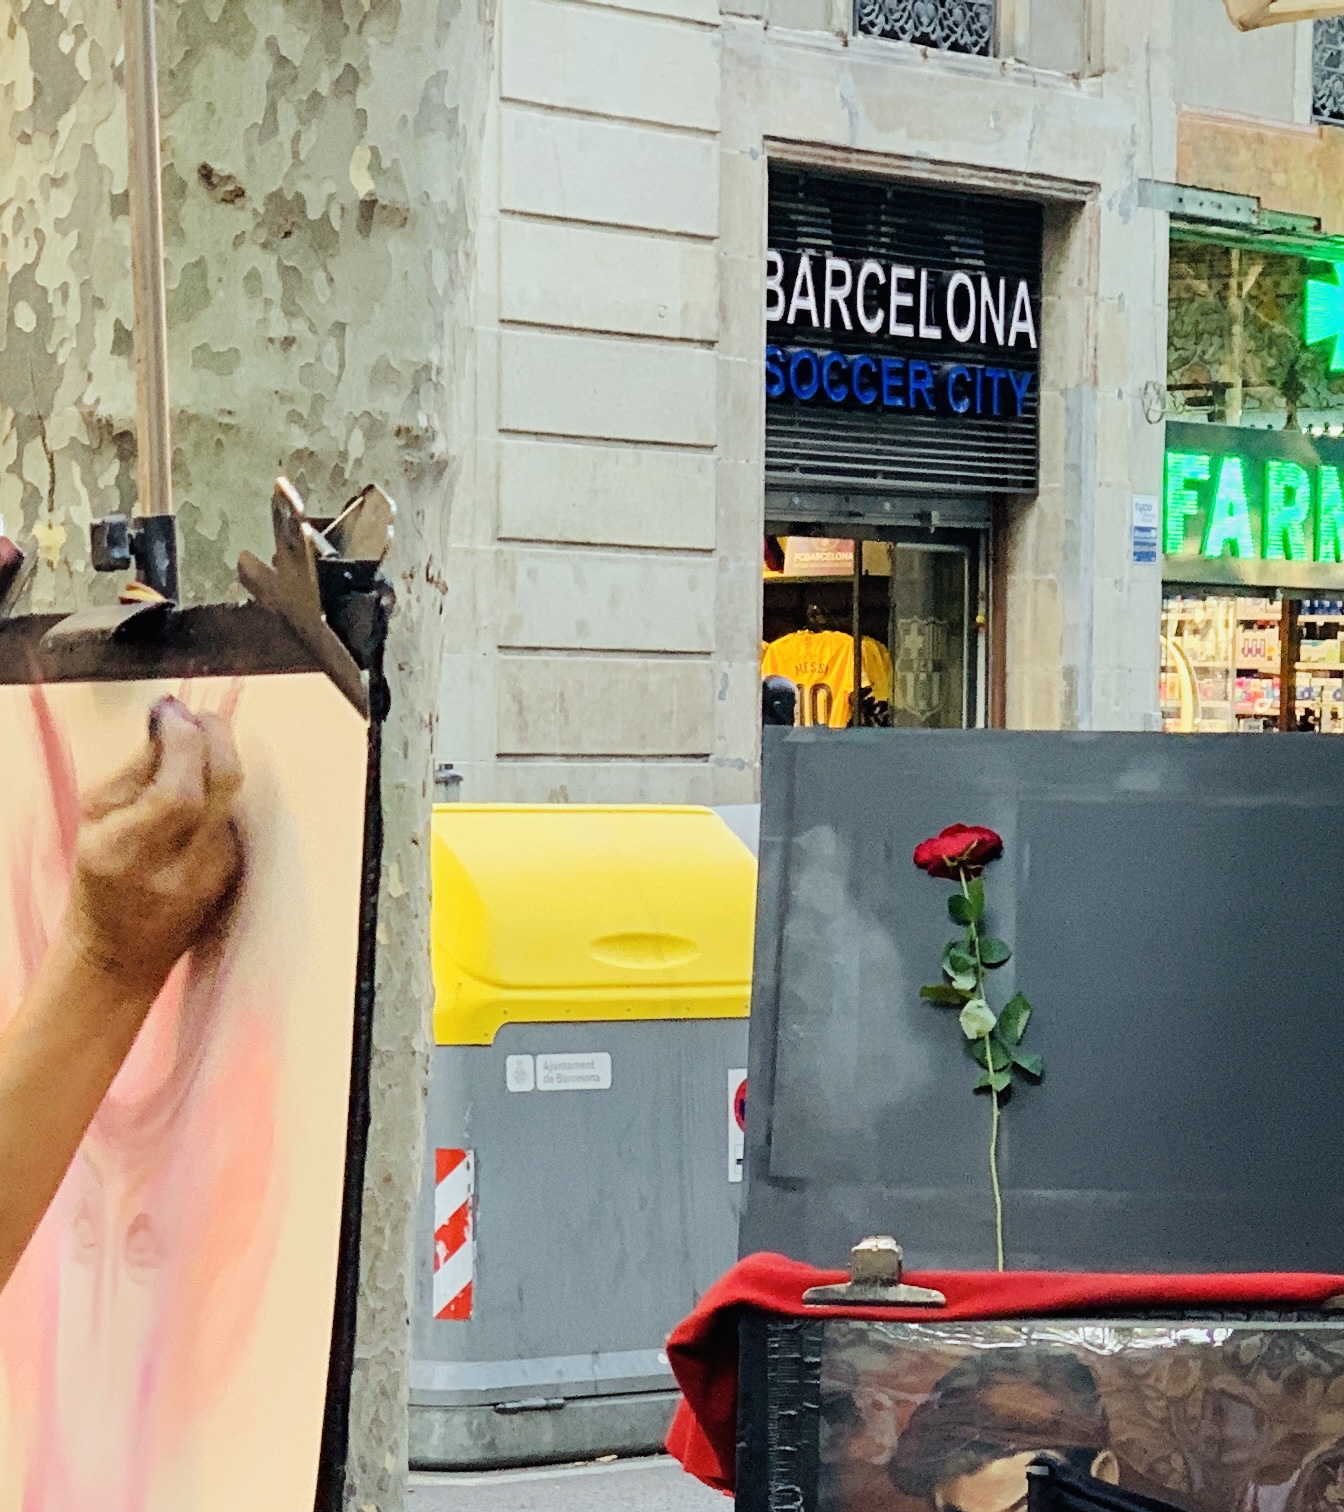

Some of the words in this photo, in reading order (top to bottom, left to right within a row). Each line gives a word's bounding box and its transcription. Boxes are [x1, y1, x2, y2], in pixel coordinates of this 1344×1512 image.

[766, 250, 1037, 348] BARCELONA
[766, 345, 936, 411] SOCCER
[948, 364, 1032, 416] CITY
[795, 661, 829, 676] MESSI
